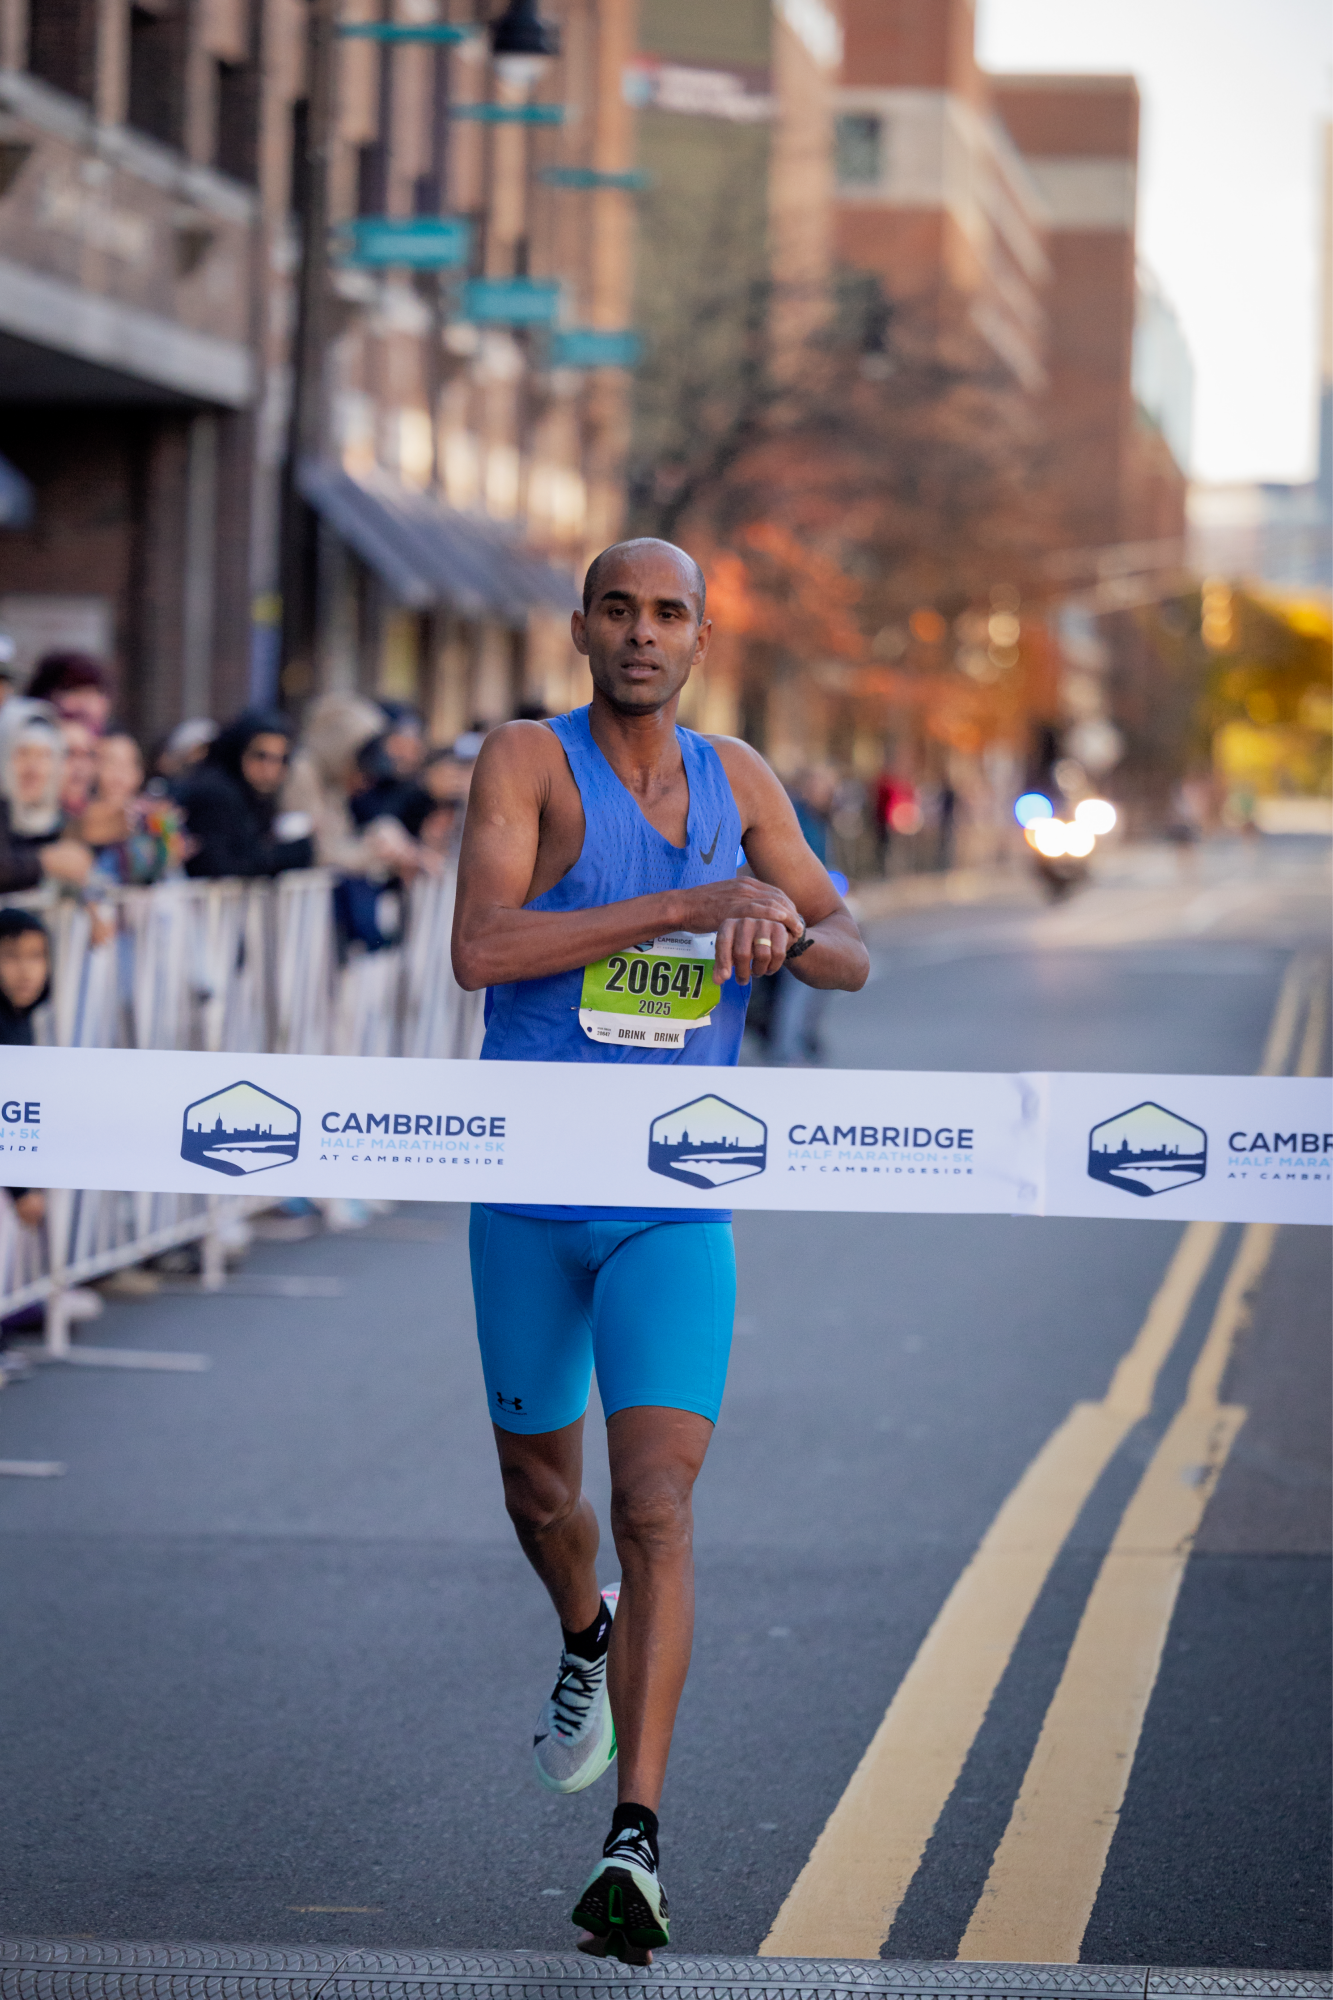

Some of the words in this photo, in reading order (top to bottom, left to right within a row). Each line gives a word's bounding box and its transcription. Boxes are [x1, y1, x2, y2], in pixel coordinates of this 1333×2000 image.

[657, 936, 692, 945] CAMBRIDGE
[605, 956, 705, 999] 20647
[638, 999, 671, 1016] 2025
[618, 1028, 646, 1041] DRINK
[654, 1031, 680, 1043] DRINK
[321, 1111, 506, 1138] CAMBRIDGE
[20, 1128, 40, 1139] 5K
[788, 1124, 974, 1149] CAMBRIDGE
[320, 1137, 365, 1149] HALF
[371, 1139, 470, 1151] MARATHON
[484, 1141, 505, 1153] 5K
[351, 1155, 504, 1165] CAMBRIDGESIDE
[787, 1149, 833, 1160] HALF
[838, 1150, 938, 1162] MARATHON
[953, 1153, 973, 1163] 5K
[1228, 1157, 1273, 1166] HALF
[1279, 1157, 1333, 1167] MARA
[819, 1165, 973, 1175] CAMBRIDGESIDE
[1260, 1173, 1330, 1181] CAMBRI
